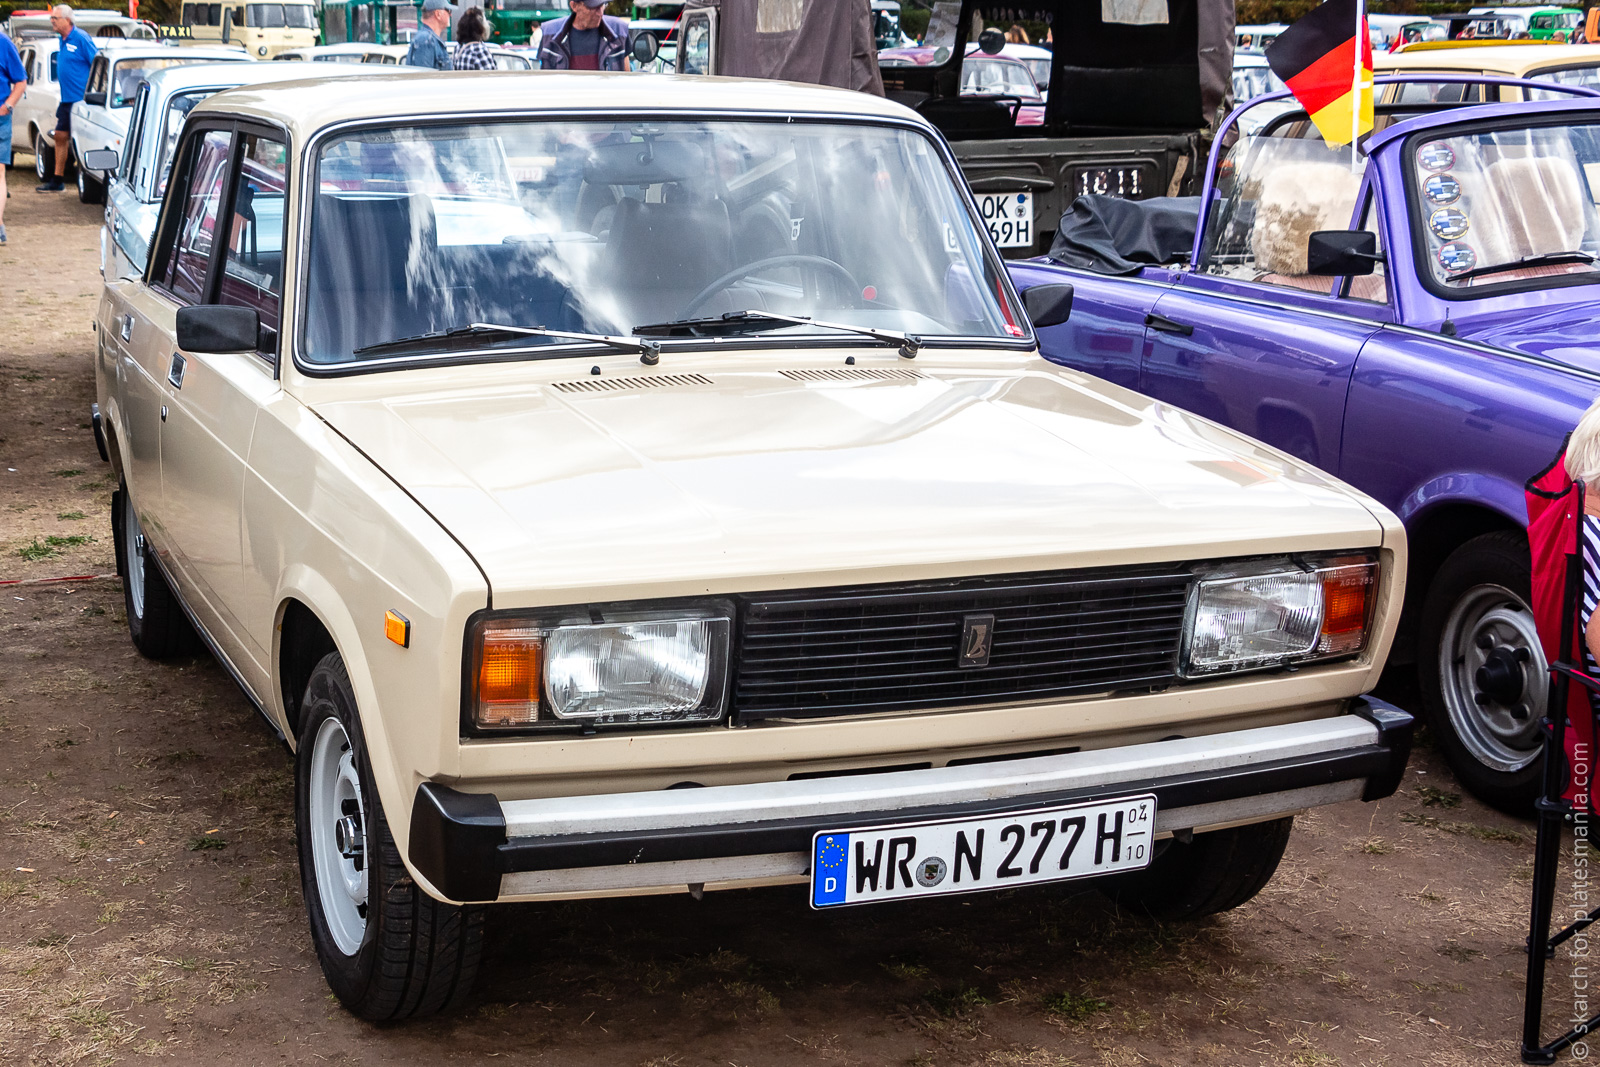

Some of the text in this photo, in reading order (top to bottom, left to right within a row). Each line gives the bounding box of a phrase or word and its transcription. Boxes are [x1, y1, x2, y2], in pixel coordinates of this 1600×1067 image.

[160, 26, 191, 37] TAXI
[982, 195, 1009, 219] OK
[492, 643, 515, 652] AGO
[1128, 804, 1147, 823] 04
[824, 877, 837, 893] D
[855, 836, 917, 893] WR
[952, 828, 985, 883] N
[1127, 844, 1145, 861] 10
